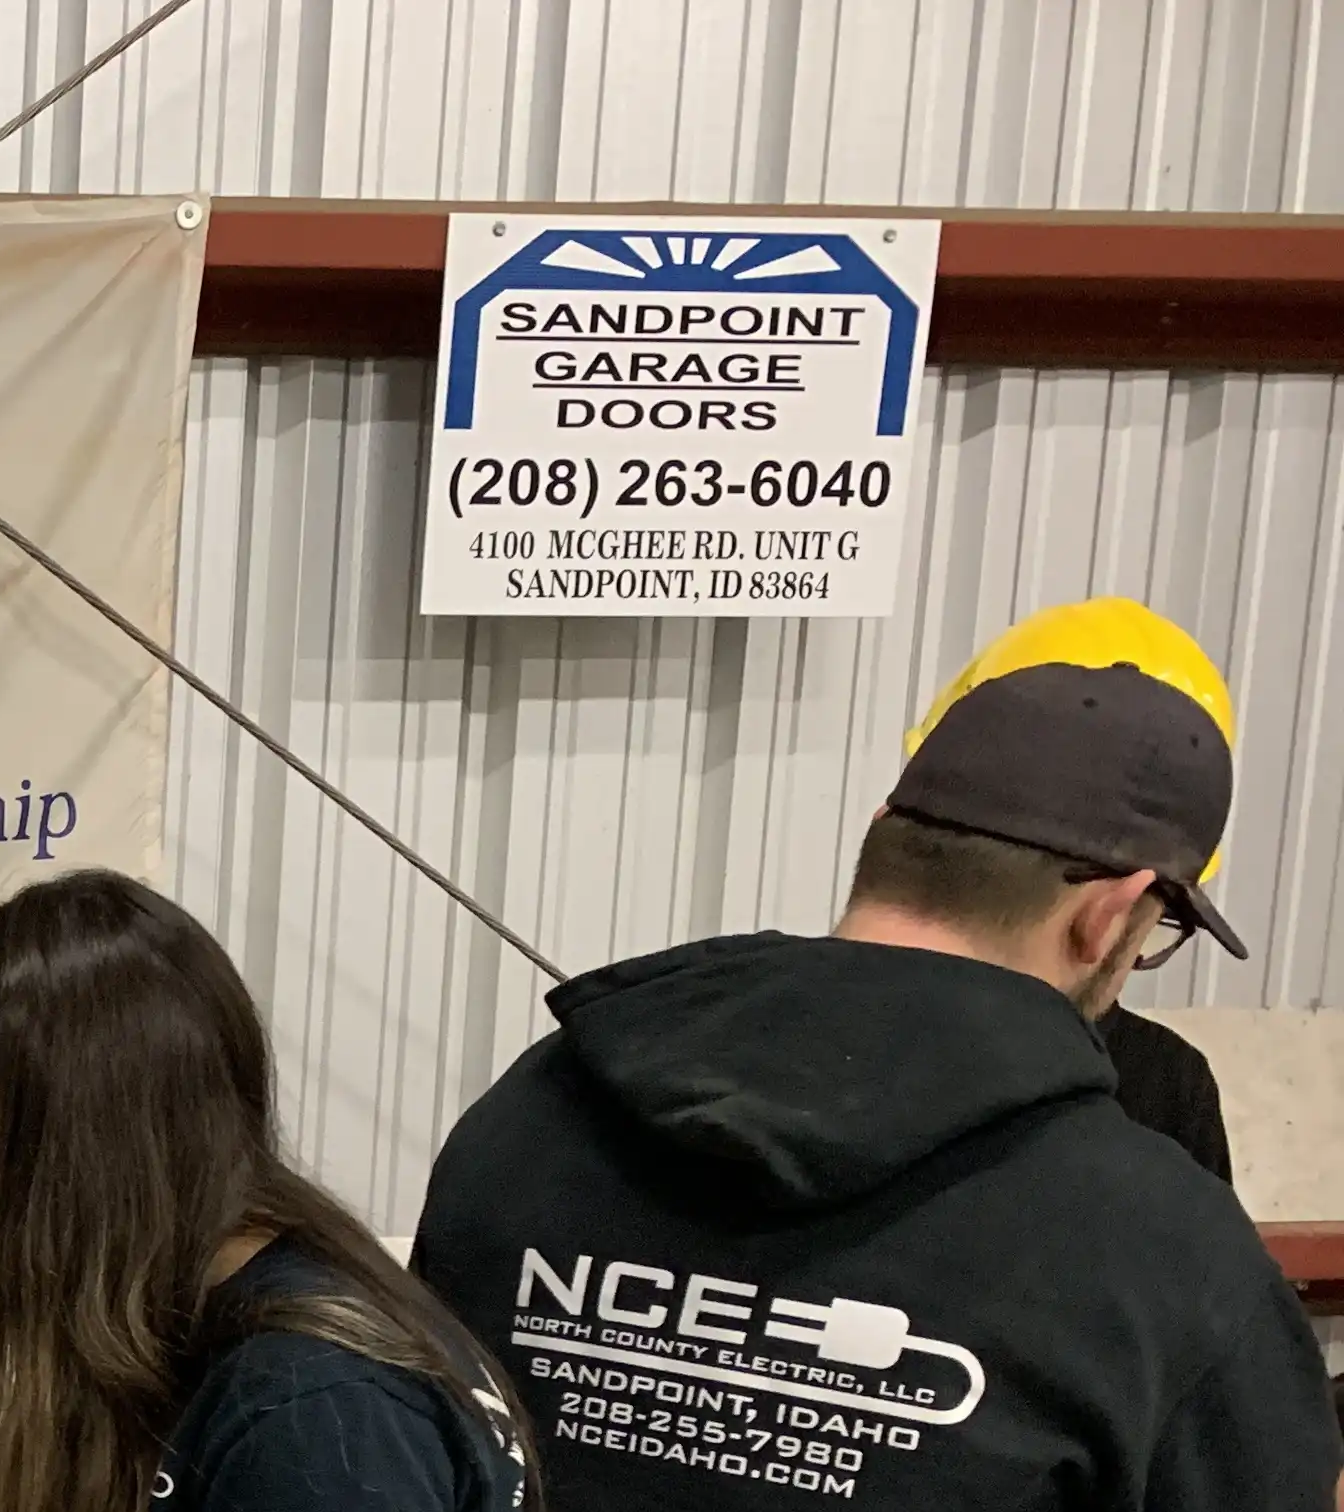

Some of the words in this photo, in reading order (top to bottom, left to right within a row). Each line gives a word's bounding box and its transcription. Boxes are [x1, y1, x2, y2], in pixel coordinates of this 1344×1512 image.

[500, 303, 866, 337] SANDPOINT
[534, 353, 802, 384] GARAGE
[556, 399, 777, 430] DOORS
[449, 458, 599, 518] (208)
[616, 459, 892, 508] 263-6040
[469, 530, 535, 560] 4100
[548, 530, 686, 561] MCGHEE
[693, 531, 745, 561] RD.
[754, 531, 831, 561] UNIT
[837, 532, 860, 562] G
[506, 569, 701, 603] SANDPOINT,
[711, 570, 742, 599] ID
[749, 571, 830, 599] 83864
[514, 1248, 759, 1346] NCE
[513, 1313, 591, 1340] NORTH
[599, 1328, 710, 1366] COUNTY
[717, 1350, 864, 1395] ELECTRIC,
[879, 1380, 936, 1405] LLC
[530, 1356, 760, 1423] SANDPOINT,
[776, 1406, 920, 1451] IDAHO
[561, 1392, 863, 1473] 208-255-7980
[555, 1418, 856, 1500] NCEIDAHO.COM
